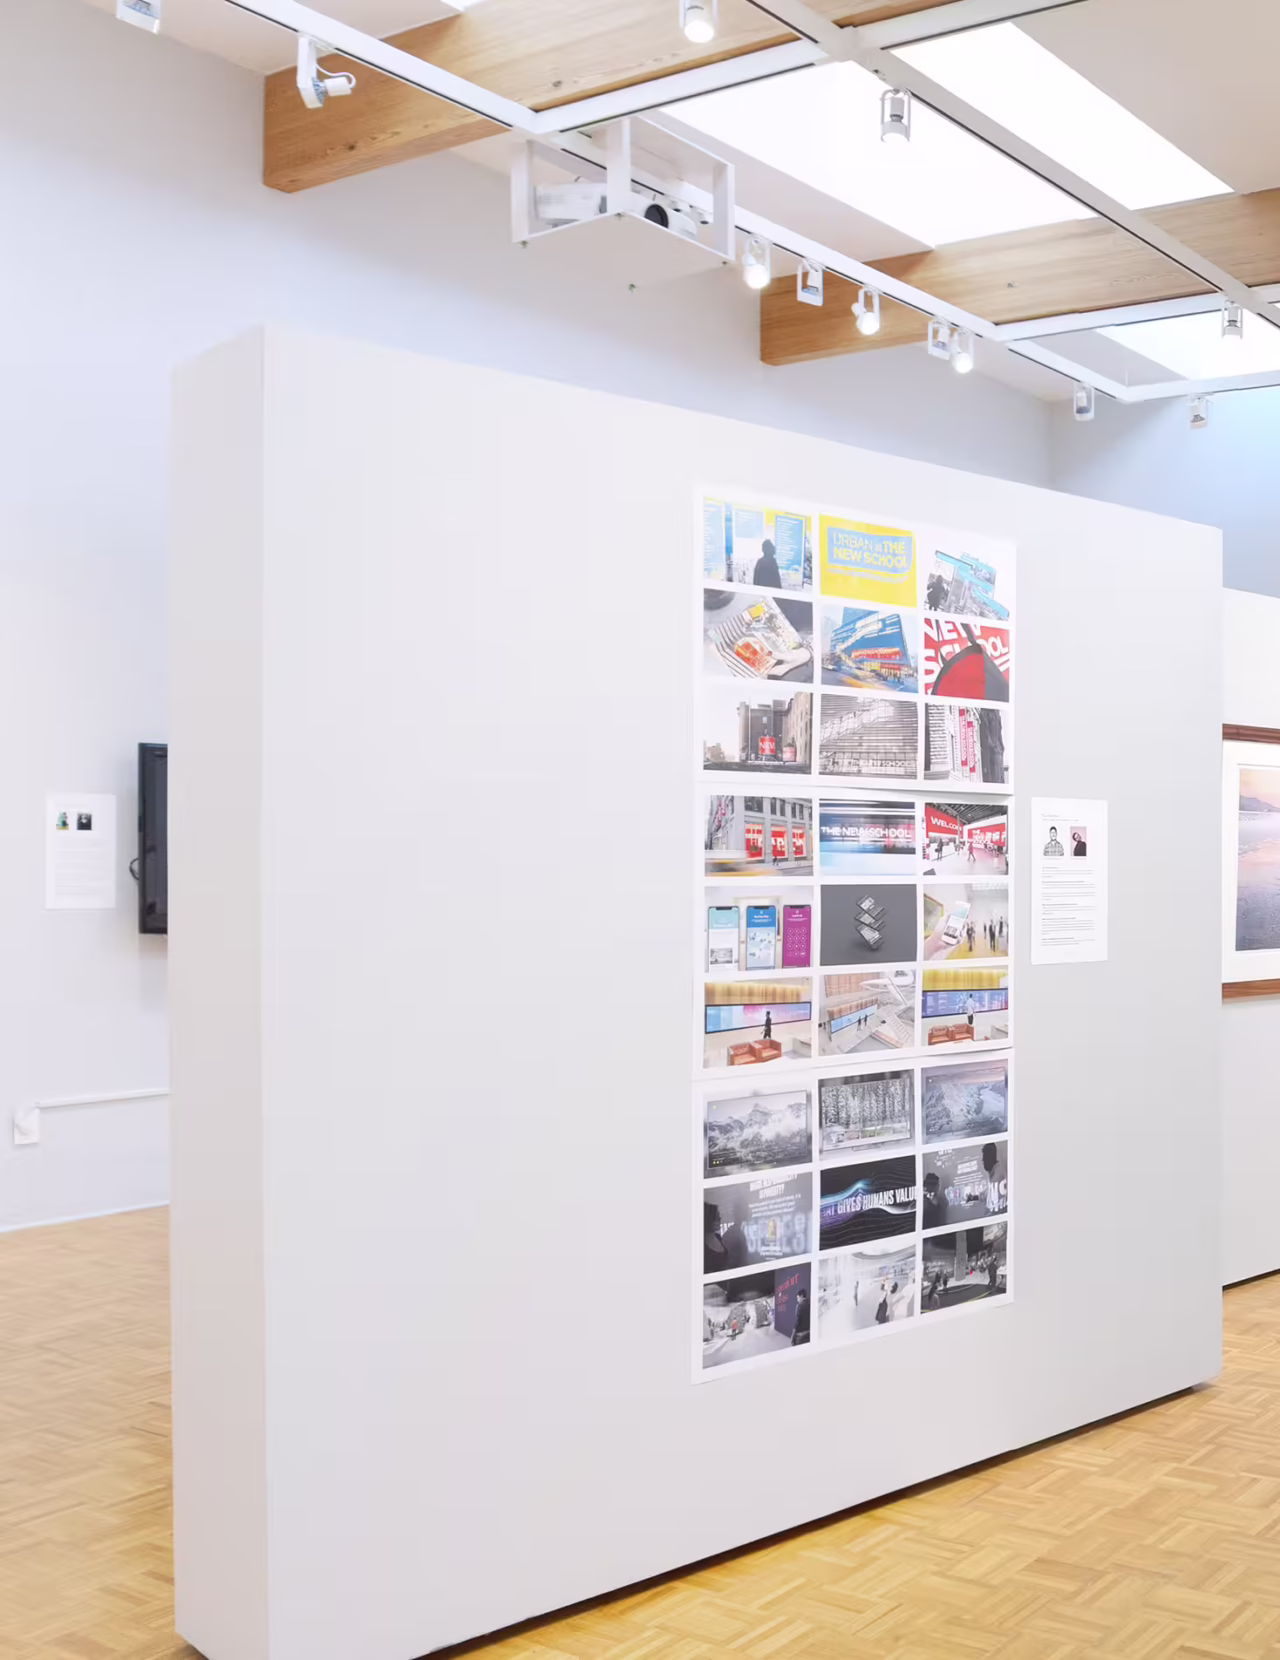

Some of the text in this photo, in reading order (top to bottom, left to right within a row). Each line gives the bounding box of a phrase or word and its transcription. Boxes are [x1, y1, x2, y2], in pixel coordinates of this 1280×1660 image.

[883, 539, 907, 555] THE
[833, 546, 907, 569] NEW SCHOOL
[842, 826, 868, 837] NEW
[869, 828, 913, 839] SCHOOL
[837, 1195, 862, 1215] GIVES
[862, 1189, 895, 1209] HUMANS
